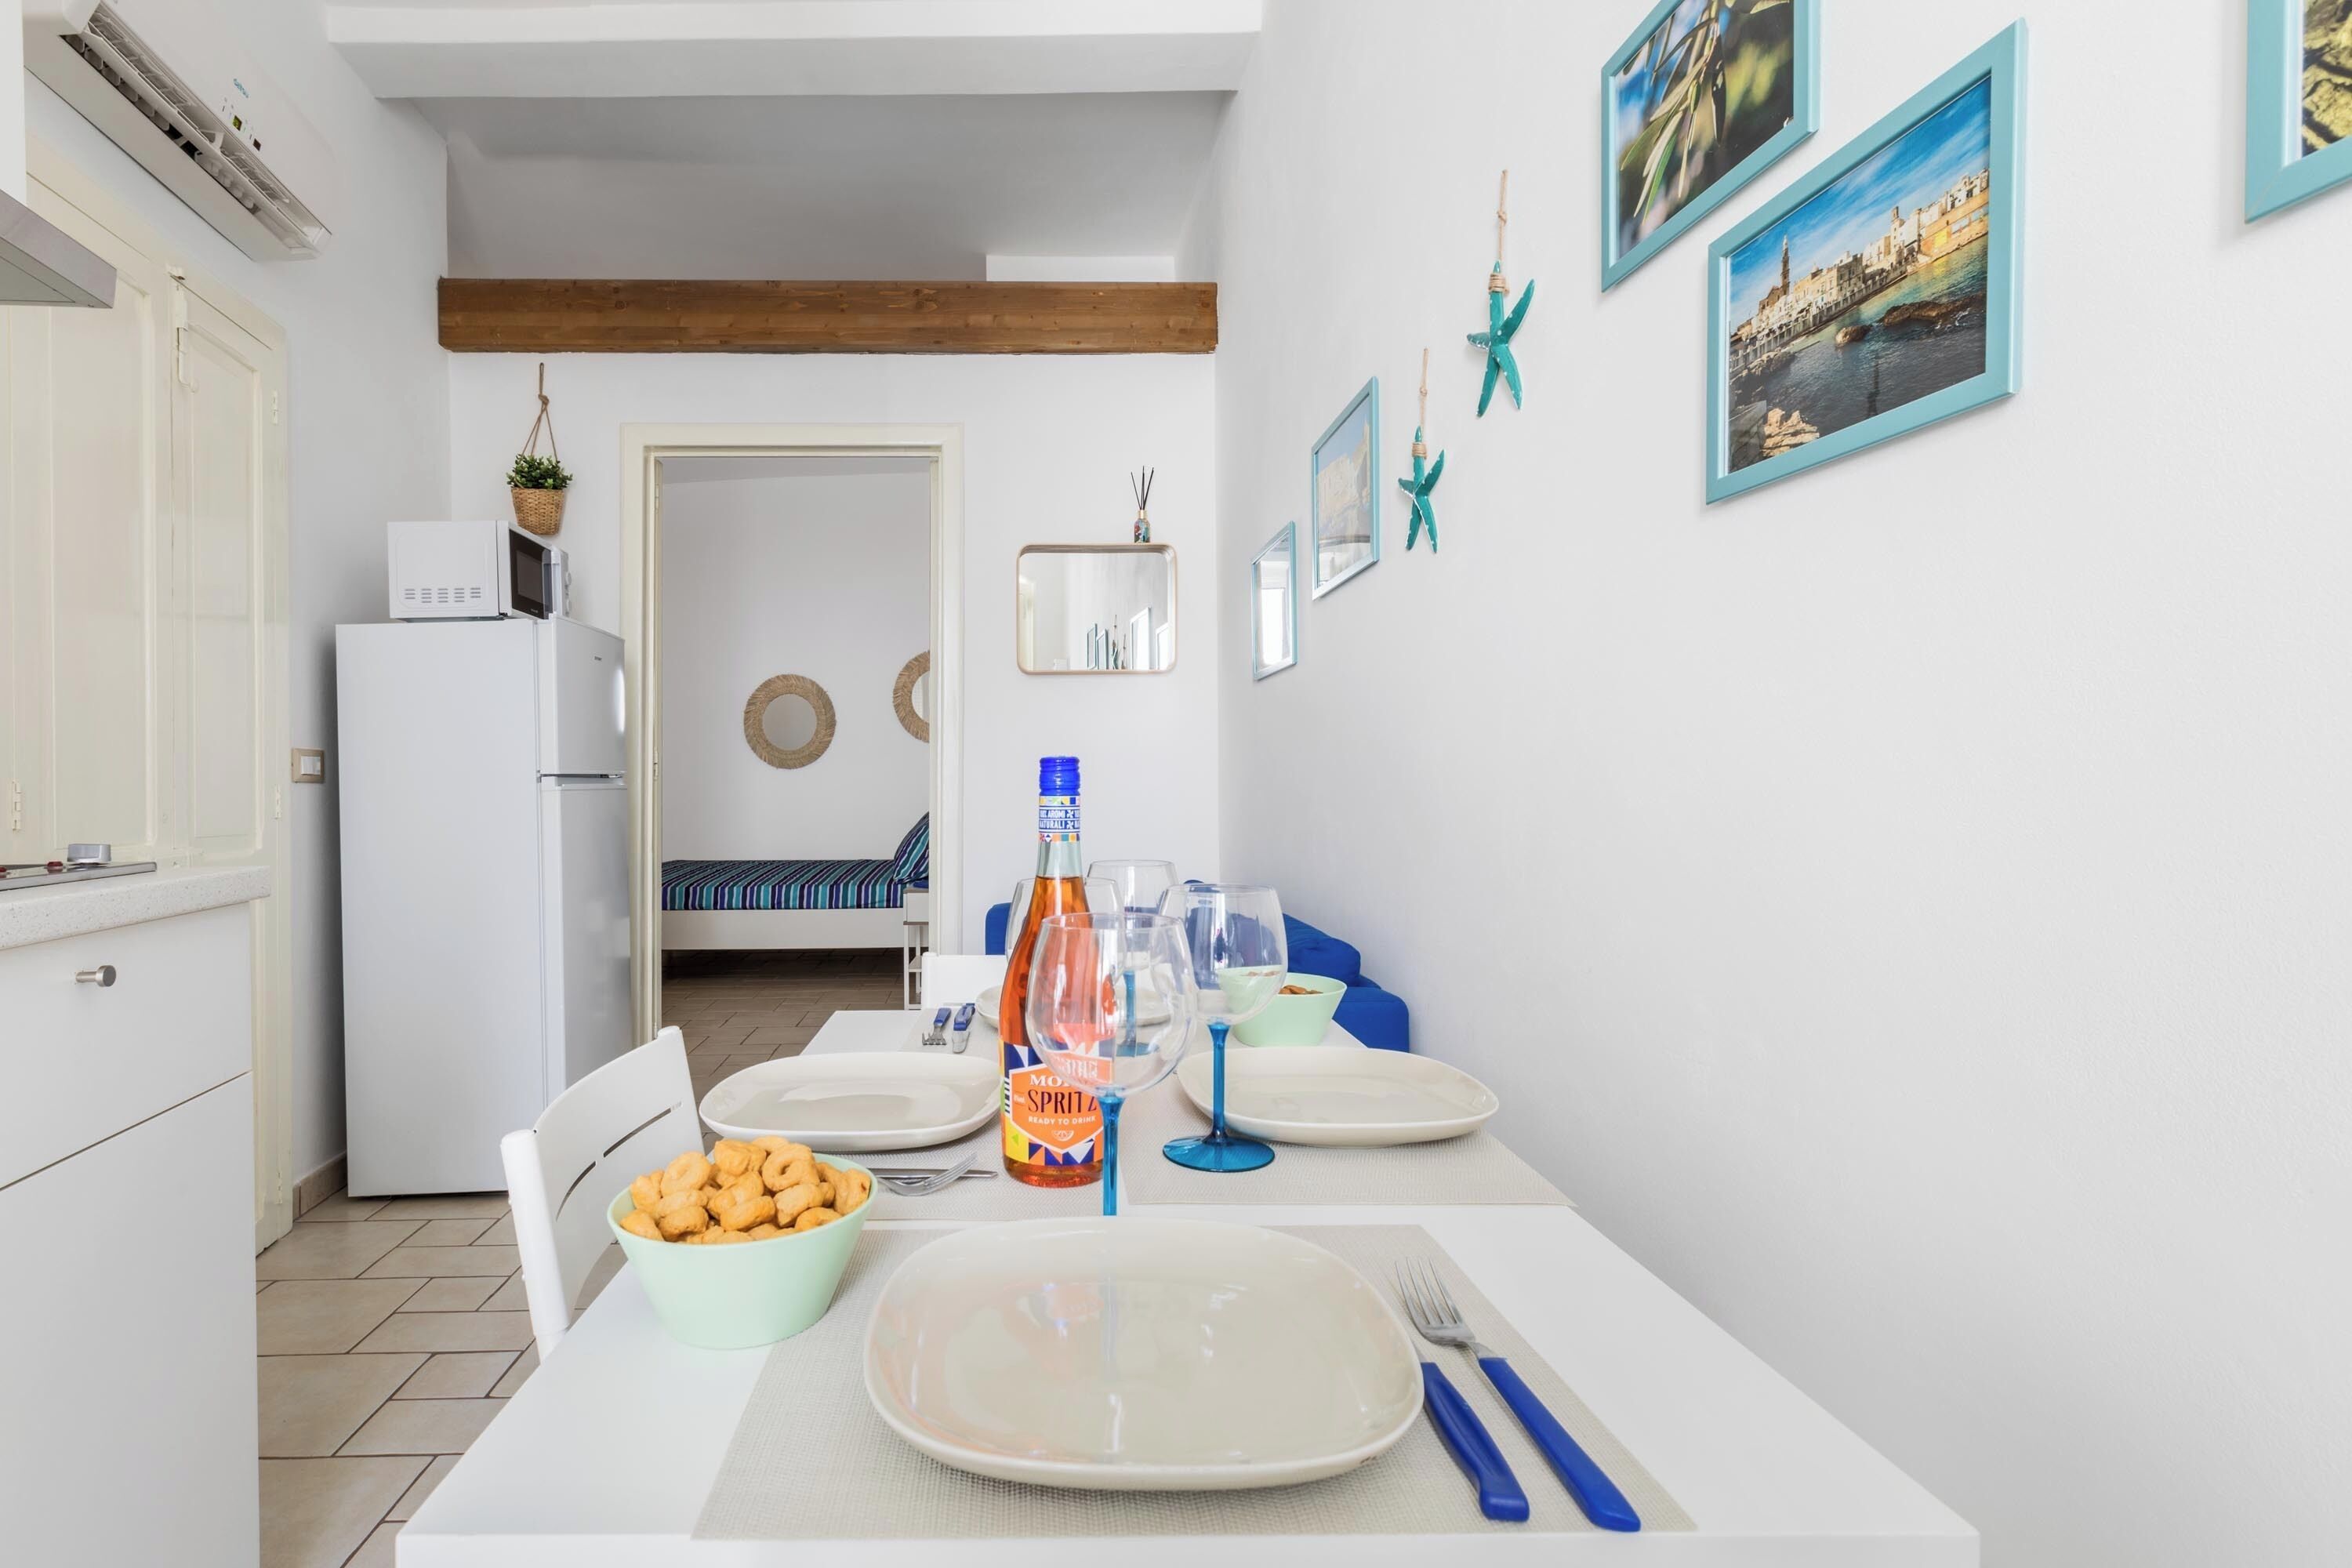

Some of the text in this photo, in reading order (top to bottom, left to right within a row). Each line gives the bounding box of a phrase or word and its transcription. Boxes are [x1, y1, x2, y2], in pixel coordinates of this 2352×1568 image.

[1028, 1089, 1097, 1114] SPRITZ
[1029, 1116, 1055, 1125] READY
[1072, 1116, 1096, 1125] DRINK
